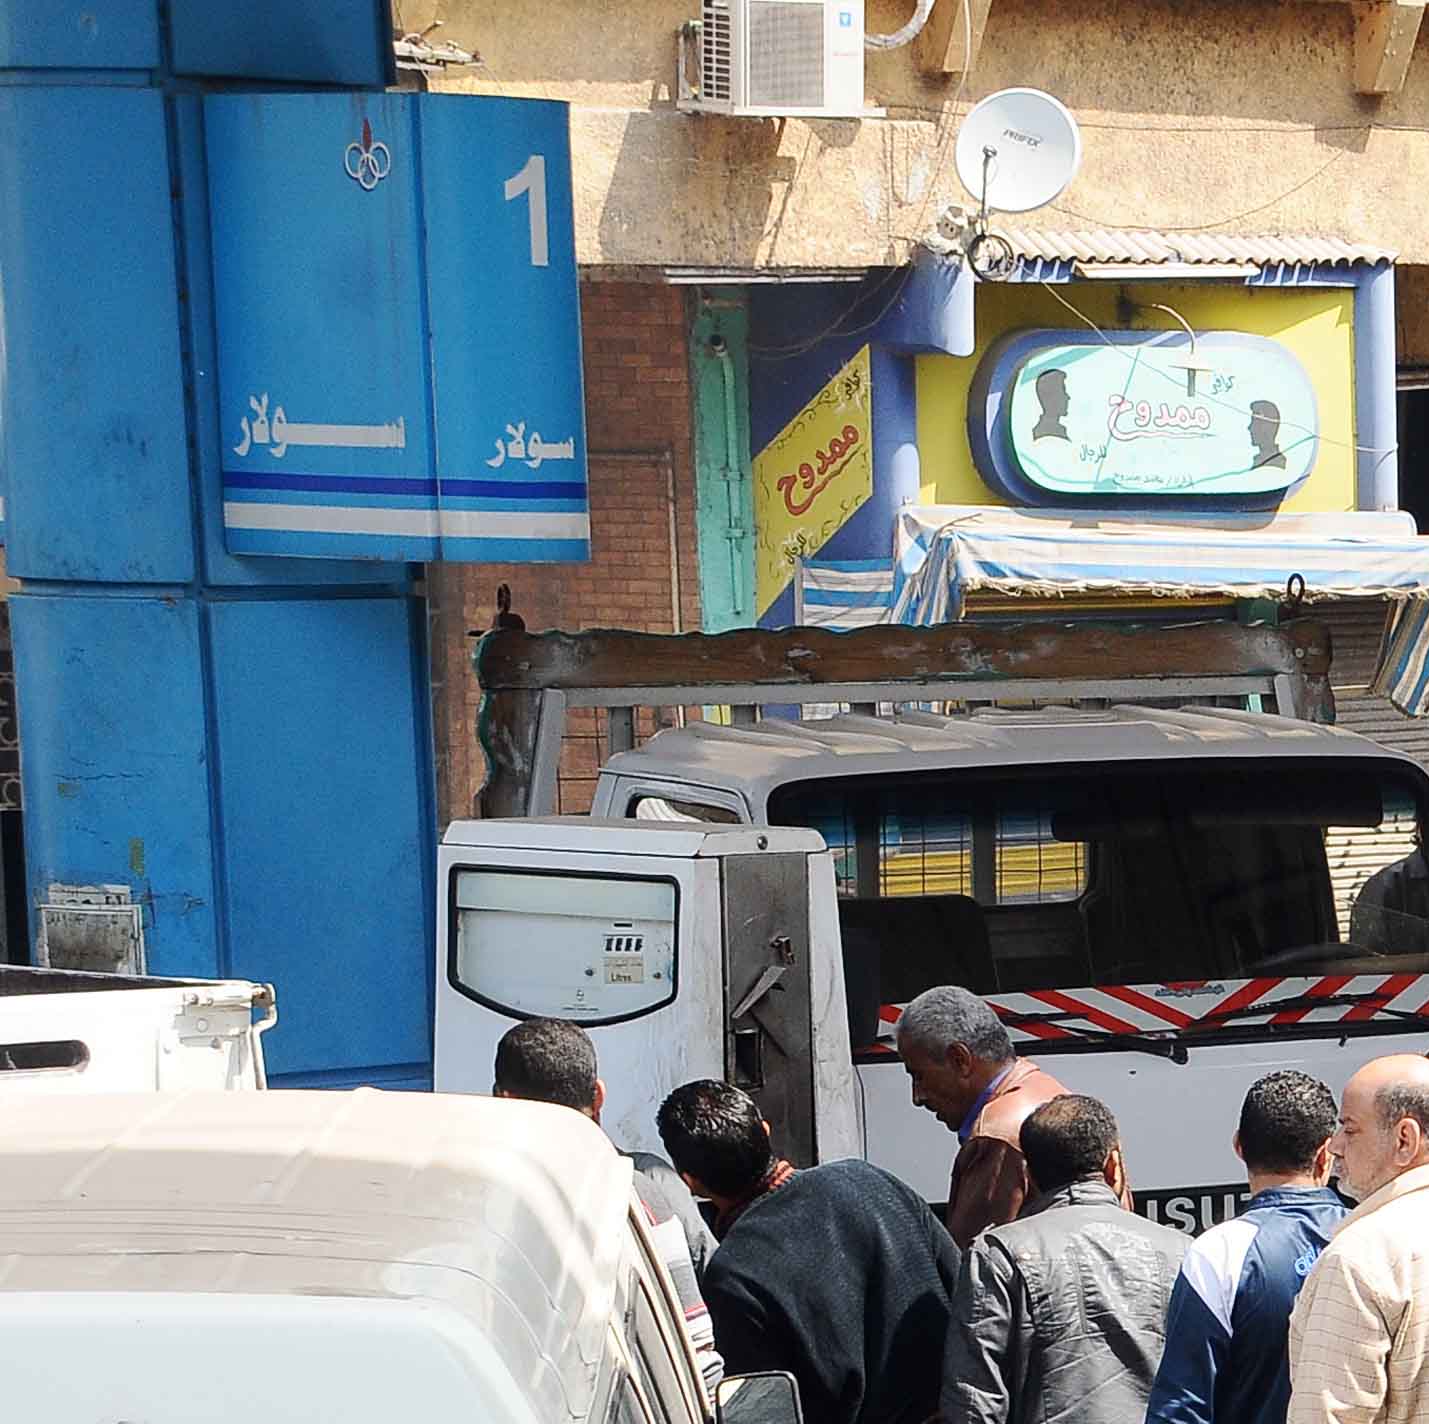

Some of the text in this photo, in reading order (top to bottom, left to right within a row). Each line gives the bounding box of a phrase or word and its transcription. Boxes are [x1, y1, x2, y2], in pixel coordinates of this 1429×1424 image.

[504, 154, 549, 266] 1
[232, 391, 406, 458] سولار
[485, 421, 575, 469] سولار
[1107, 394, 1217, 442] ممدوح
[777, 425, 864, 516] ممدوح
[1145, 1195, 1251, 1237] ISU
